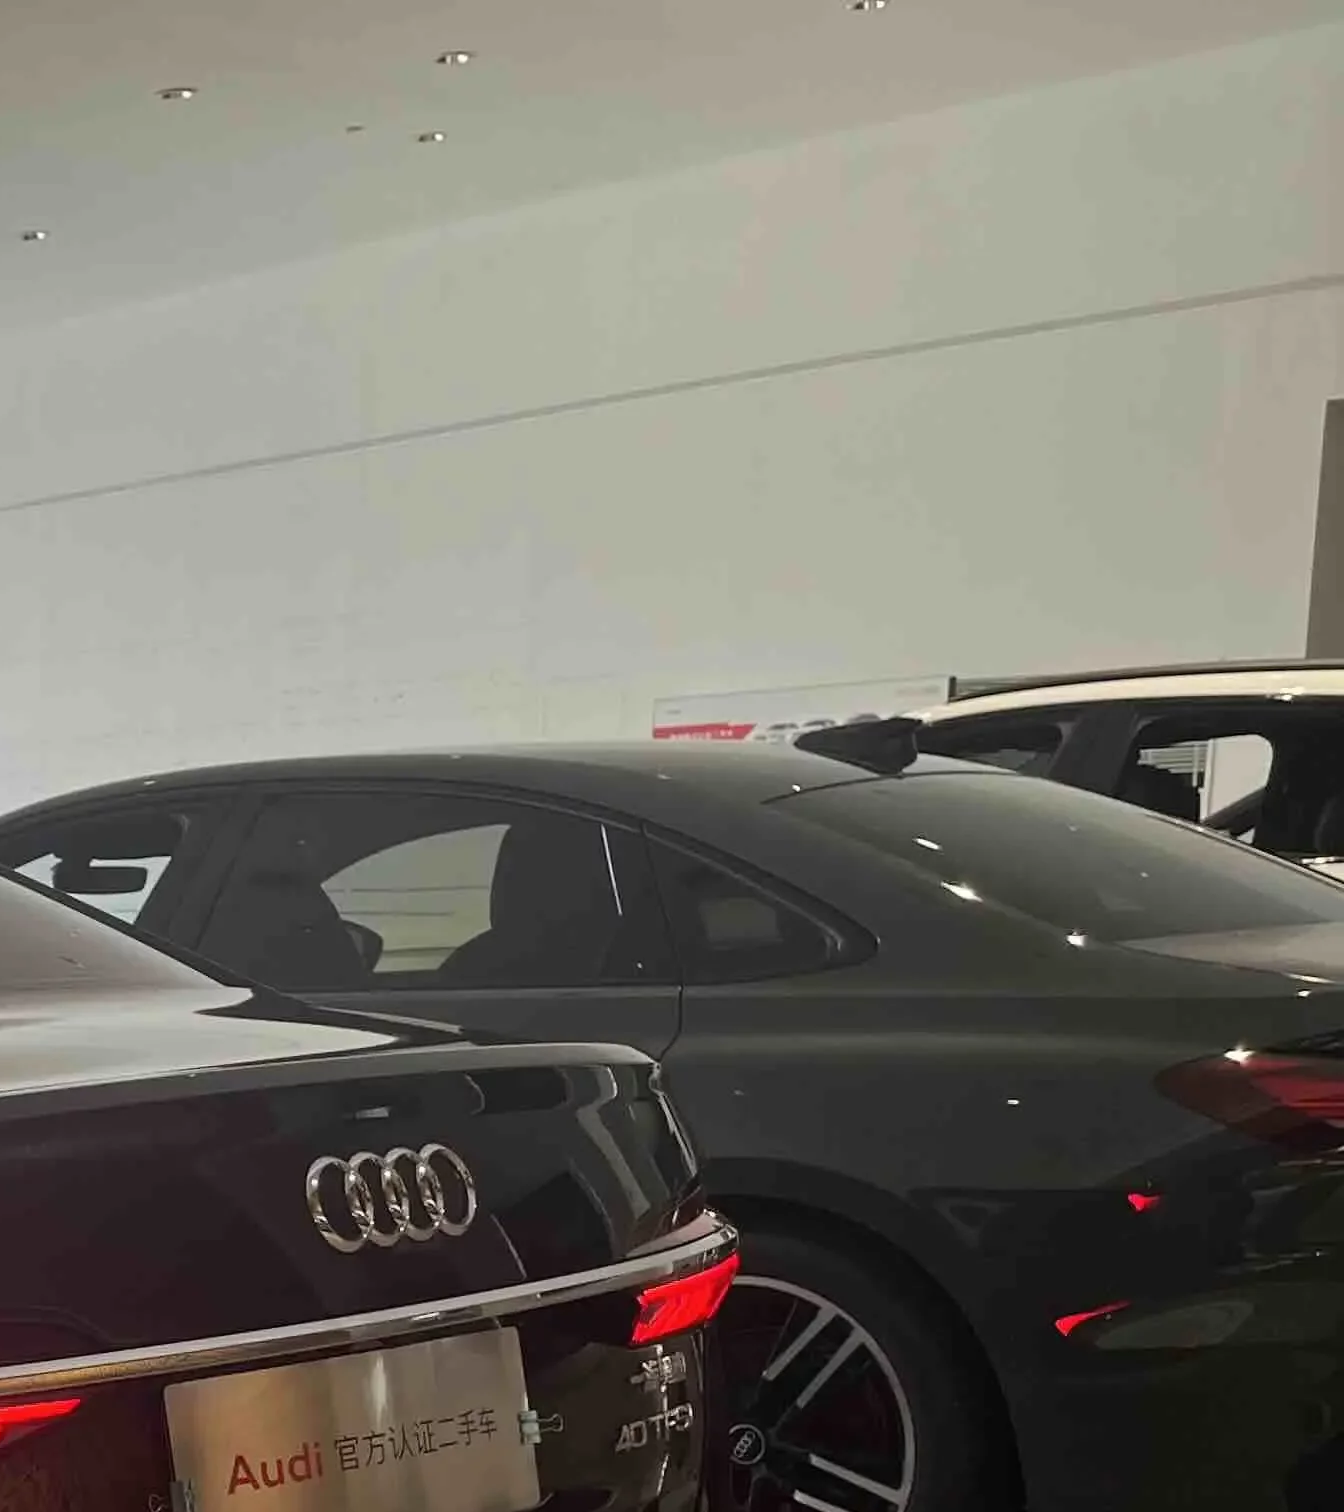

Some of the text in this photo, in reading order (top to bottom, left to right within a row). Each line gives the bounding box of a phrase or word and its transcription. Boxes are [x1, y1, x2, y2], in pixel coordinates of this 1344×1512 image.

[226, 1407, 499, 1496] Audi 官方认证二手车
